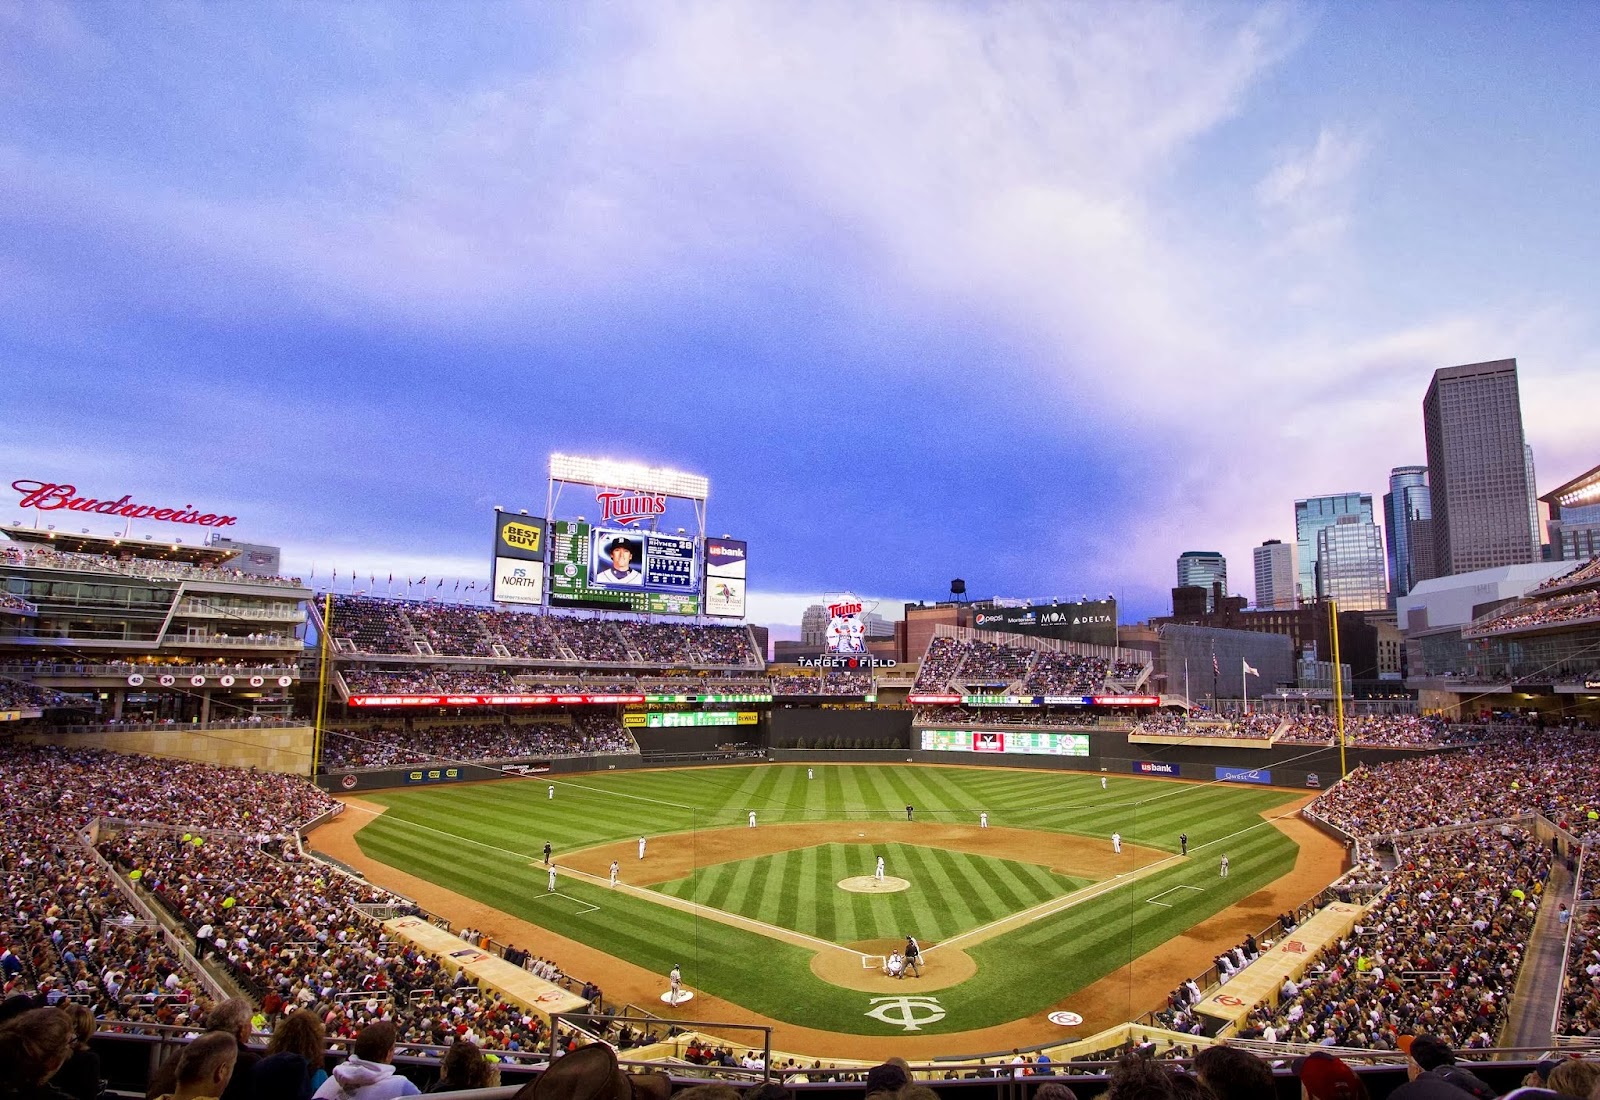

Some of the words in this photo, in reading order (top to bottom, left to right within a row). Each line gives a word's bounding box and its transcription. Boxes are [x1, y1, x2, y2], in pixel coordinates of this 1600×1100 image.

[12, 480, 237, 527] Budweiser
[596, 490, 666, 521] Twins
[508, 526, 539, 540] BEST
[508, 535, 535, 547] BUY
[513, 568, 527, 577] FS
[501, 576, 535, 587] NORTH
[828, 602, 862, 619] Twins
[984, 614, 1004, 624] pepsi
[1082, 615, 1112, 624] DELTA
[798, 656, 848, 667] TARGET
[860, 656, 897, 667] FIELD
